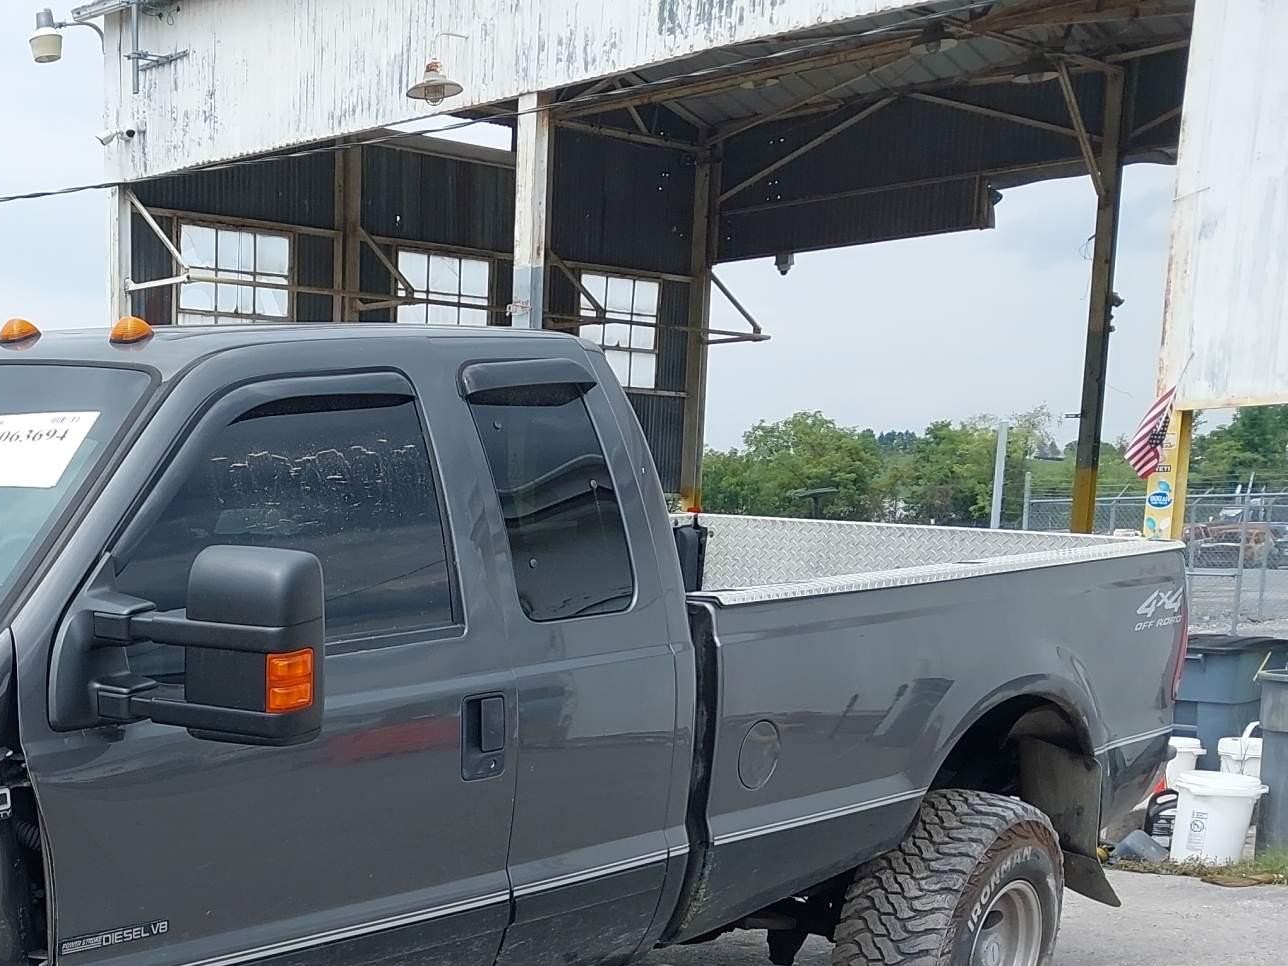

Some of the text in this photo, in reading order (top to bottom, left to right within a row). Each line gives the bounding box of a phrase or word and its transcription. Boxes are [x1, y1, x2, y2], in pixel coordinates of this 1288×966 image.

[1135, 615, 1183, 631] OFF ROAD
[967, 845, 1032, 933] IRONMAN
[103, 926, 150, 946] DIESEL
[151, 921, 168, 935] V8
